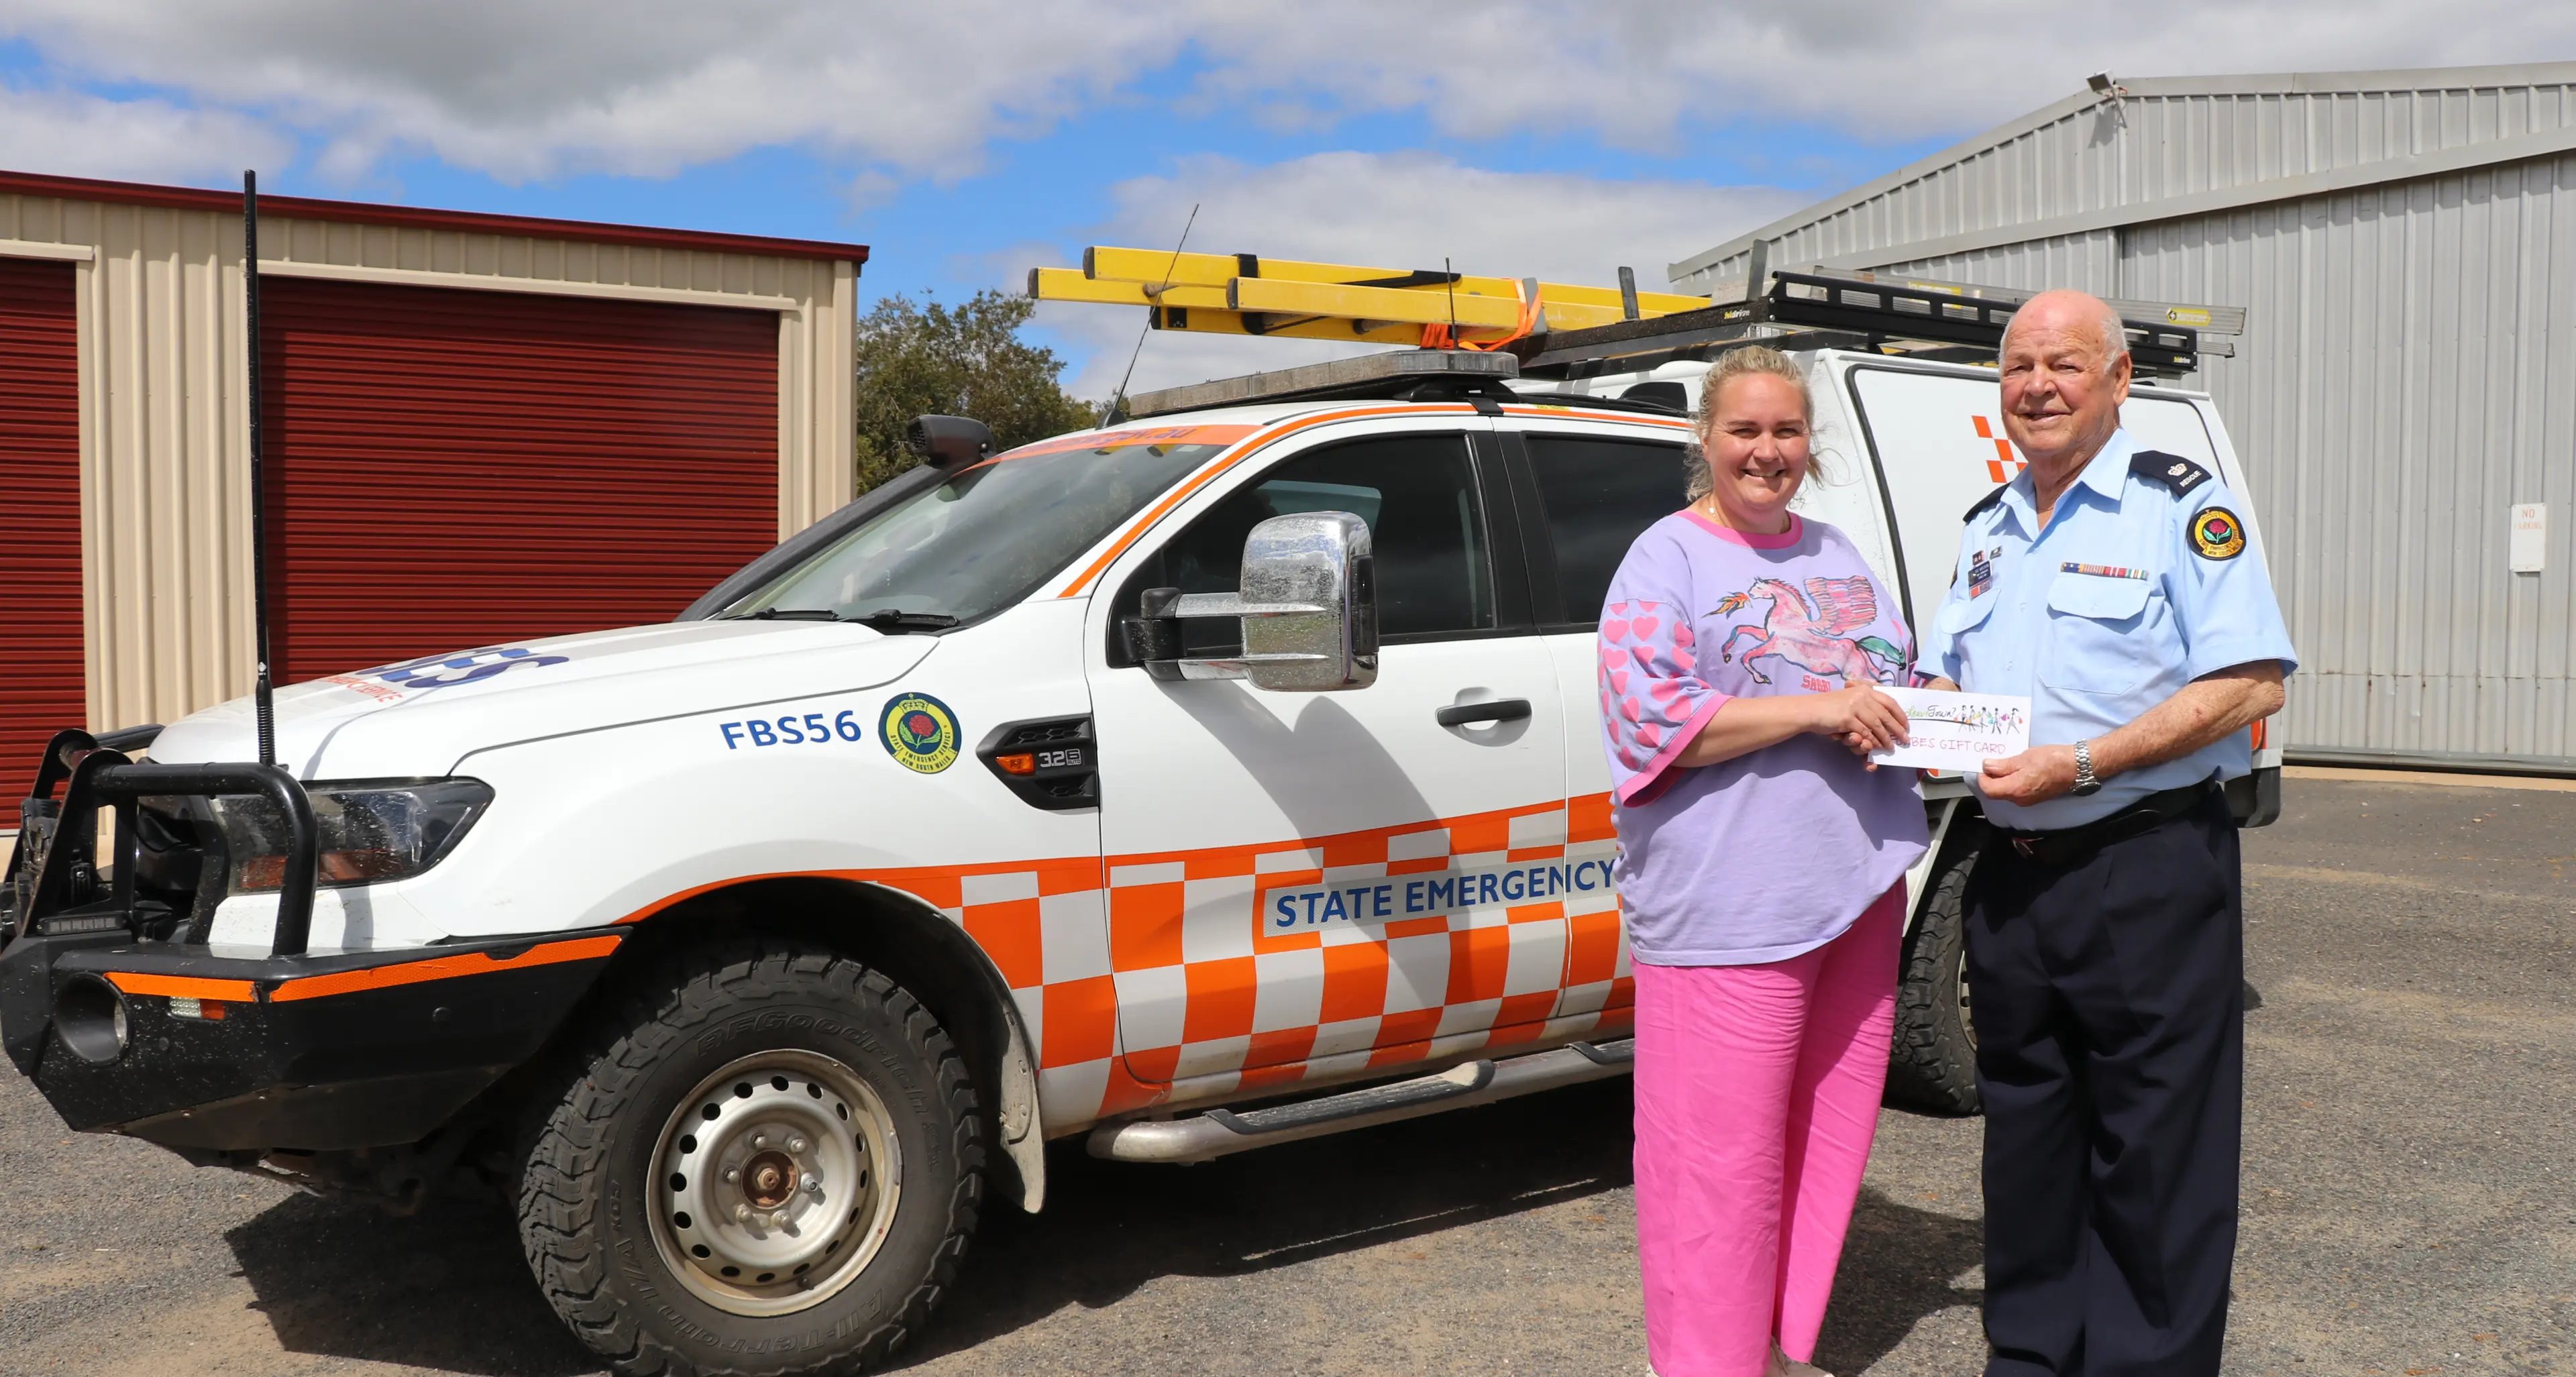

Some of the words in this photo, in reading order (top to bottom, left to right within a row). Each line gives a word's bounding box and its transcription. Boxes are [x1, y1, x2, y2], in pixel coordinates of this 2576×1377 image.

[2179, 470, 2202, 488] RESCUE
[2522, 508, 2535, 518] NO
[2514, 521, 2542, 531] PARKING
[719, 710, 862, 750] FBS56
[890, 734, 904, 751] STATE
[905, 751, 938, 763] EMERGENCY
[938, 732, 951, 755] SERVICE
[1890, 734, 1935, 749] FOBES
[1939, 739, 1971, 752] GIFT
[1973, 742, 2006, 755] CARD
[902, 757, 914, 767] NEW
[936, 755, 951, 769] WALES
[1276, 885, 1392, 927] STATE
[1406, 859, 1615, 912] EMERGENCY
